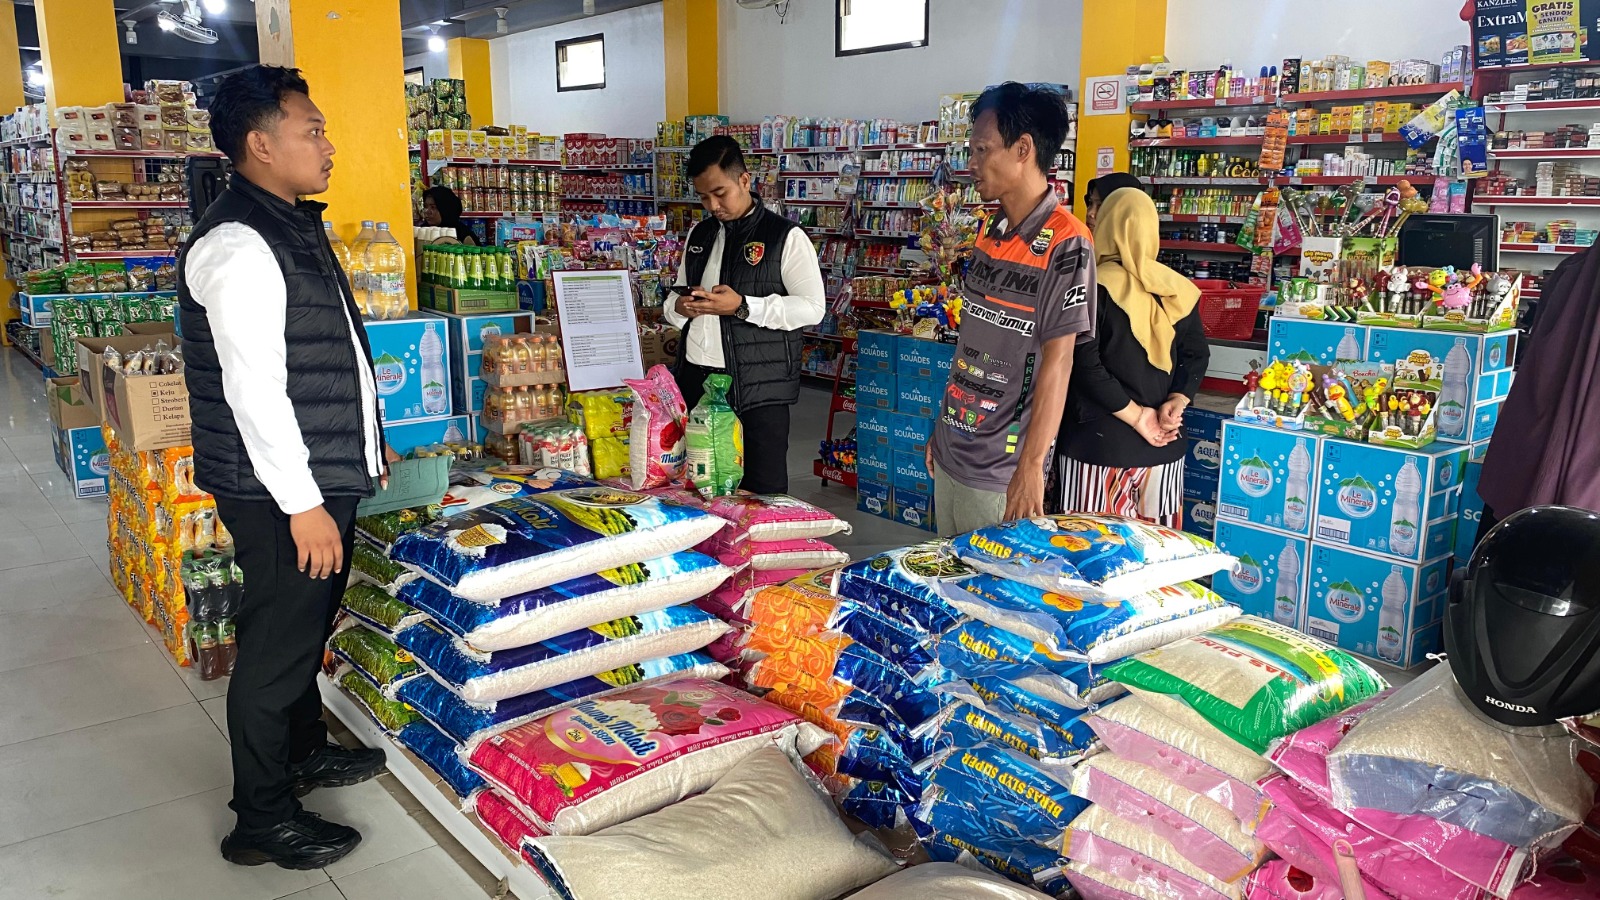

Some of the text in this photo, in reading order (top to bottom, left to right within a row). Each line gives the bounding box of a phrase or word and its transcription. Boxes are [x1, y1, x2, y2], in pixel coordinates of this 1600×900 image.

[1531, 1, 1573, 13] GRATIS
[1540, 10, 1573, 18] SENDOK
[1001, 270, 1040, 294] INK
[1062, 285, 1087, 309] 25
[970, 304, 998, 322] seven
[980, 400, 998, 412] 100%
[1197, 447, 1219, 458] AQUA
[1240, 473, 1269, 485] Minerale
[1341, 494, 1373, 507] Minerale
[1352, 490, 1361, 498] Le
[970, 534, 1013, 559] SUPER
[1232, 571, 1259, 584] Minerale
[1330, 597, 1360, 611] Minerale
[958, 630, 998, 660] SUPER
[1296, 642, 1334, 669] PADI
[1485, 695, 1538, 713] HONDA
[966, 712, 1003, 738] SUPER
[605, 720, 657, 756] Melati
[961, 753, 999, 779] SUPER
[998, 772, 1026, 794] SLYP
[1025, 786, 1065, 819] BERAS
